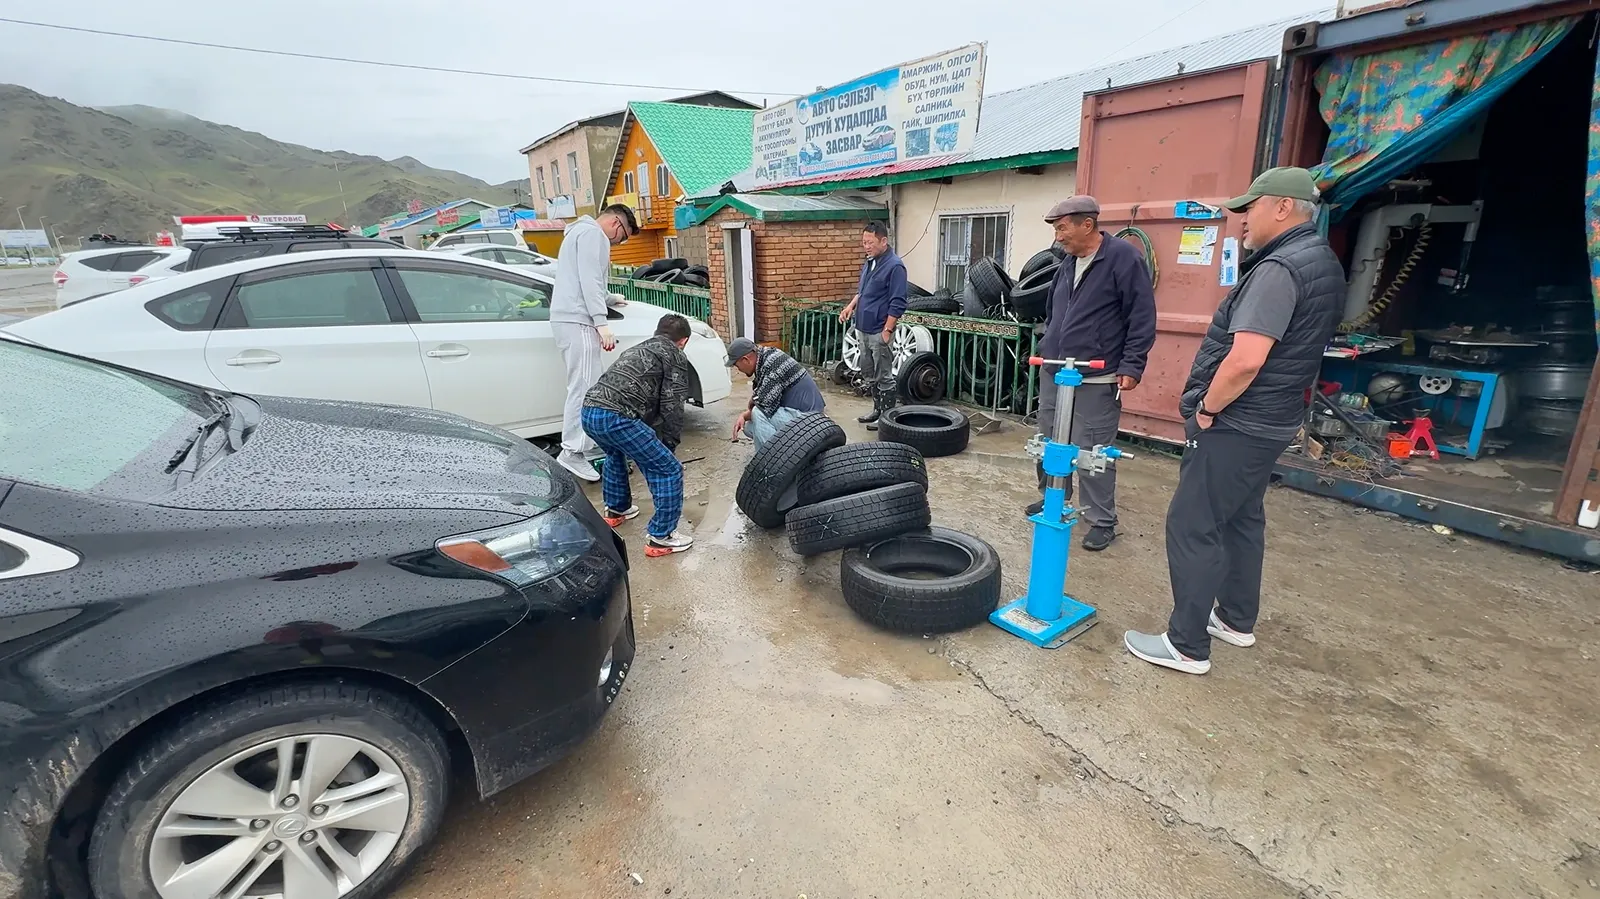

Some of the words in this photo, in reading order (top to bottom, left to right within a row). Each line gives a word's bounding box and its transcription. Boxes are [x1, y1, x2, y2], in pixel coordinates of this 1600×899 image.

[901, 62, 945, 80] АМАРЖИН,
[947, 50, 979, 68] ОЛГОЙ
[951, 67, 971, 80] ЦАП
[812, 97, 835, 118] АВТО
[838, 84, 877, 110] СЭЛБЭГ
[907, 92, 923, 103] БҮХ
[925, 82, 965, 100] ТӨРЛИЙН
[915, 98, 953, 114] САЛНИКА
[924, 108, 966, 125] ШИПИЛКА
[805, 116, 832, 142] ДУГУЙ
[834, 105, 888, 133] ХУДАЛДАА
[826, 134, 862, 155] ЗАСВАР
